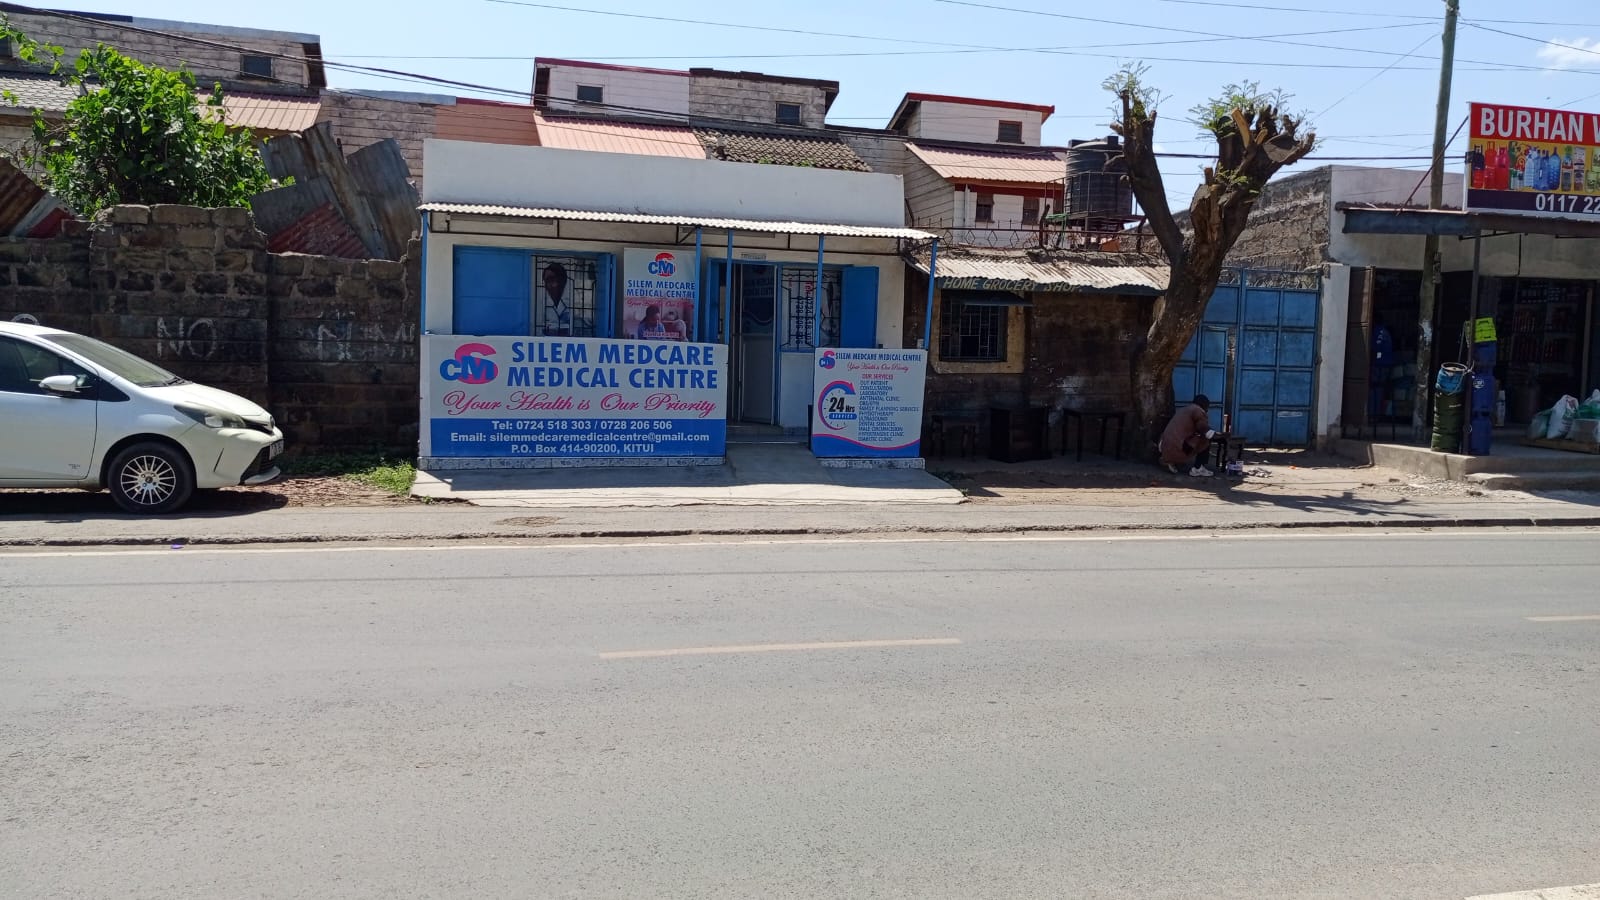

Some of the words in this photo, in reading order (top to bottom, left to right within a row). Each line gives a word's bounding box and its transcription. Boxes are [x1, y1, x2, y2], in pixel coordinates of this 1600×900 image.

[1480, 108, 1584, 142] BURHAN
[1535, 193, 1577, 212] 0117
[628, 280, 652, 288] SILEM
[656, 281, 695, 290] MEDCARE
[943, 278, 979, 289] HOME
[982, 279, 1037, 291] GROCERY
[626, 289, 663, 297] MEDICAL
[157, 316, 218, 360] NO
[511, 342, 588, 363] SILEM
[599, 344, 714, 366] MEDCARE
[836, 352, 852, 360] SILEM
[852, 352, 877, 361] MEDCARE
[878, 353, 901, 361] MEDICAL
[903, 354, 921, 362] CENTRE
[507, 367, 619, 388] MEDICAL
[628, 369, 718, 389] CENTRE
[443, 390, 502, 415] Your
[506, 390, 574, 411] Health
[573, 396, 590, 411] is
[600, 393, 639, 411] Our
[644, 393, 716, 418] Priority
[829, 397, 845, 412] 24
[492, 421, 513, 430] Tel:
[516, 421, 544, 430] 0724
[547, 421, 568, 430] 518
[571, 421, 591, 430] 303
[600, 421, 628, 430] 0728
[630, 421, 650, 430] 206
[653, 421, 672, 430] 506
[450, 432, 487, 442] Email:
[490, 432, 710, 444] silemmedcaremedicalcentre@gmail.com
[511, 444, 532, 453] P.O.
[535, 444, 557, 453] Box
[559, 444, 621, 454] 414-90200,
[623, 444, 654, 453] KITUI
